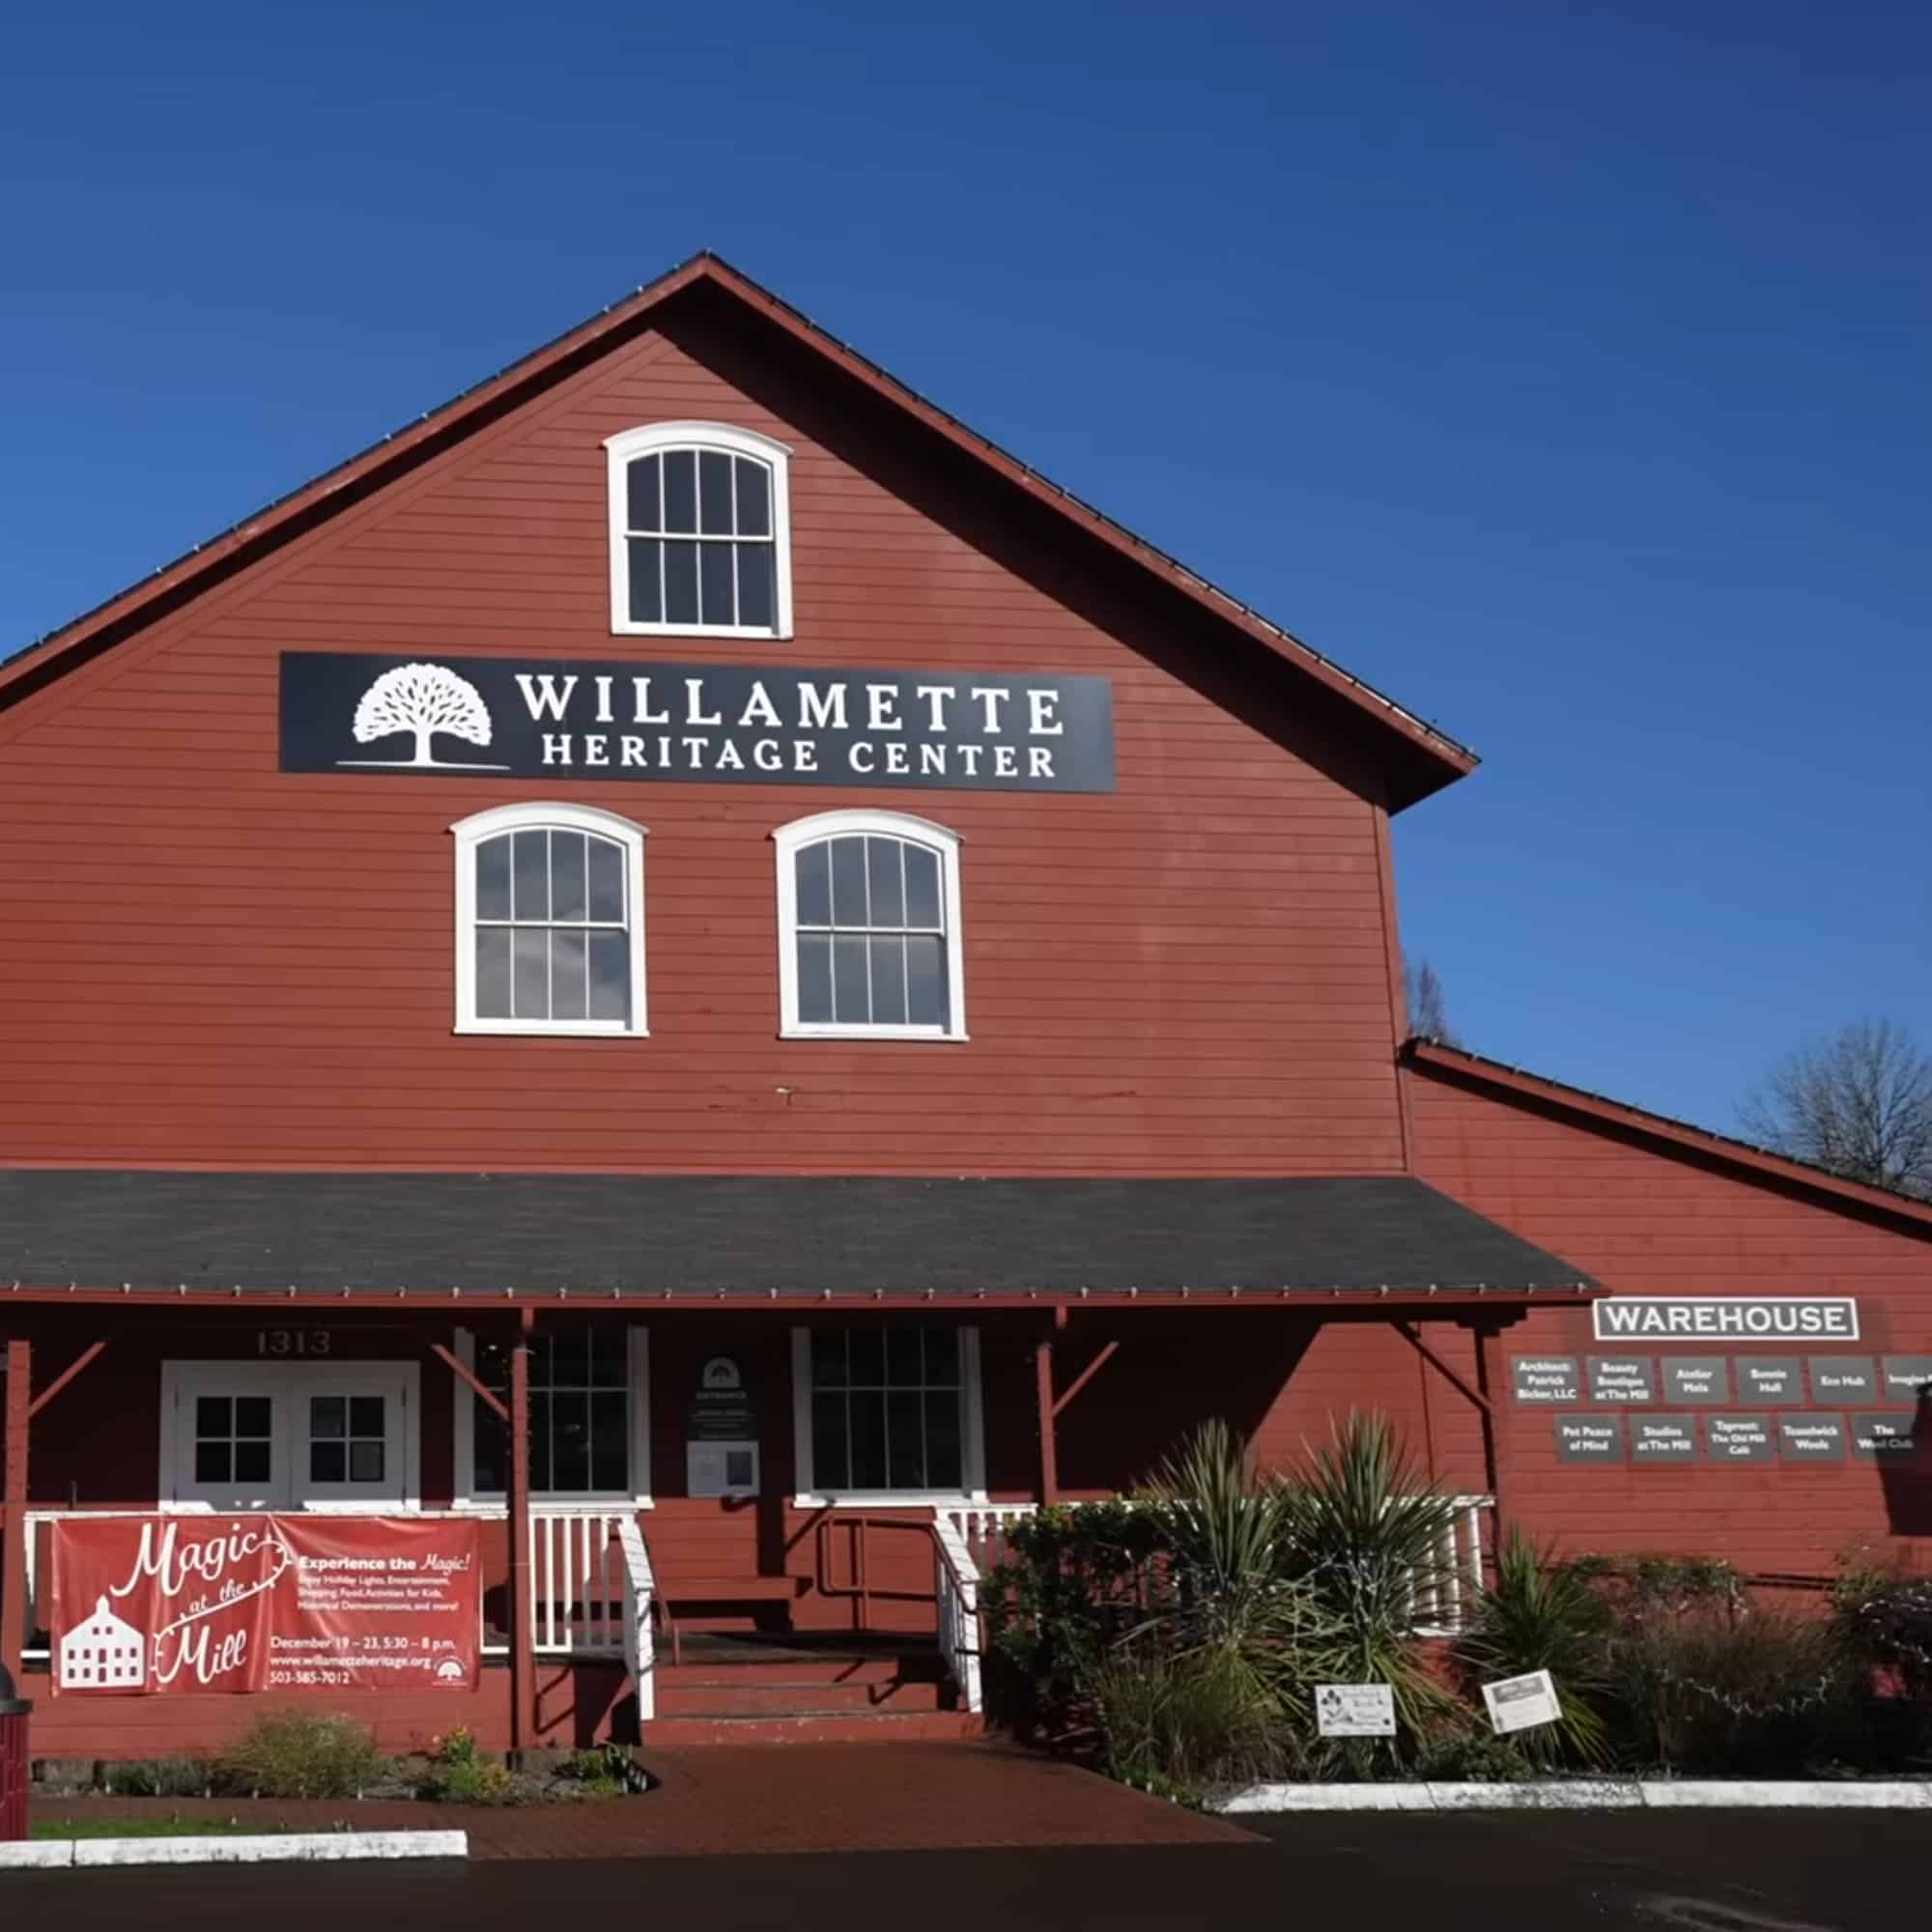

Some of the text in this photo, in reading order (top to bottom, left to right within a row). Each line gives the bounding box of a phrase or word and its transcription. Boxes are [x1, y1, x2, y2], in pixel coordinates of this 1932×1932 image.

[515, 673, 1065, 736] WILLAMETTE
[542, 733, 1056, 779] HERITAGE CENTER
[1605, 1305, 1847, 1332] WAREHOUSE
[256, 1330, 331, 1353] 1313
[1841, 1376, 1865, 1386] Hub
[1554, 1389, 1577, 1399] LLC
[1606, 1389, 1628, 1400] The
[1630, 1389, 1649, 1400] Mill
[1562, 1426, 1580, 1437] Pet
[1873, 1424, 1896, 1436] The
[1569, 1439, 1608, 1450] of Mind
[1648, 1439, 1670, 1450] The
[1671, 1439, 1691, 1450] Mill
[1711, 1434, 1767, 1443] The Old Mill
[109, 1521, 258, 1598] Magic
[299, 1553, 471, 1576] Experience the Magic!
[324, 1575, 356, 1587] Holiday
[189, 1577, 246, 1614] at the
[407, 1588, 419, 1598] for
[414, 1600, 430, 1611] and
[270, 1635, 332, 1650] December
[336, 1636, 350, 1650] 19
[383, 1636, 408, 1650] 5:30
[421, 1636, 430, 1650] 8
[156, 1625, 247, 1685] Mill
[270, 1654, 433, 1670] www.willametteheritage.org
